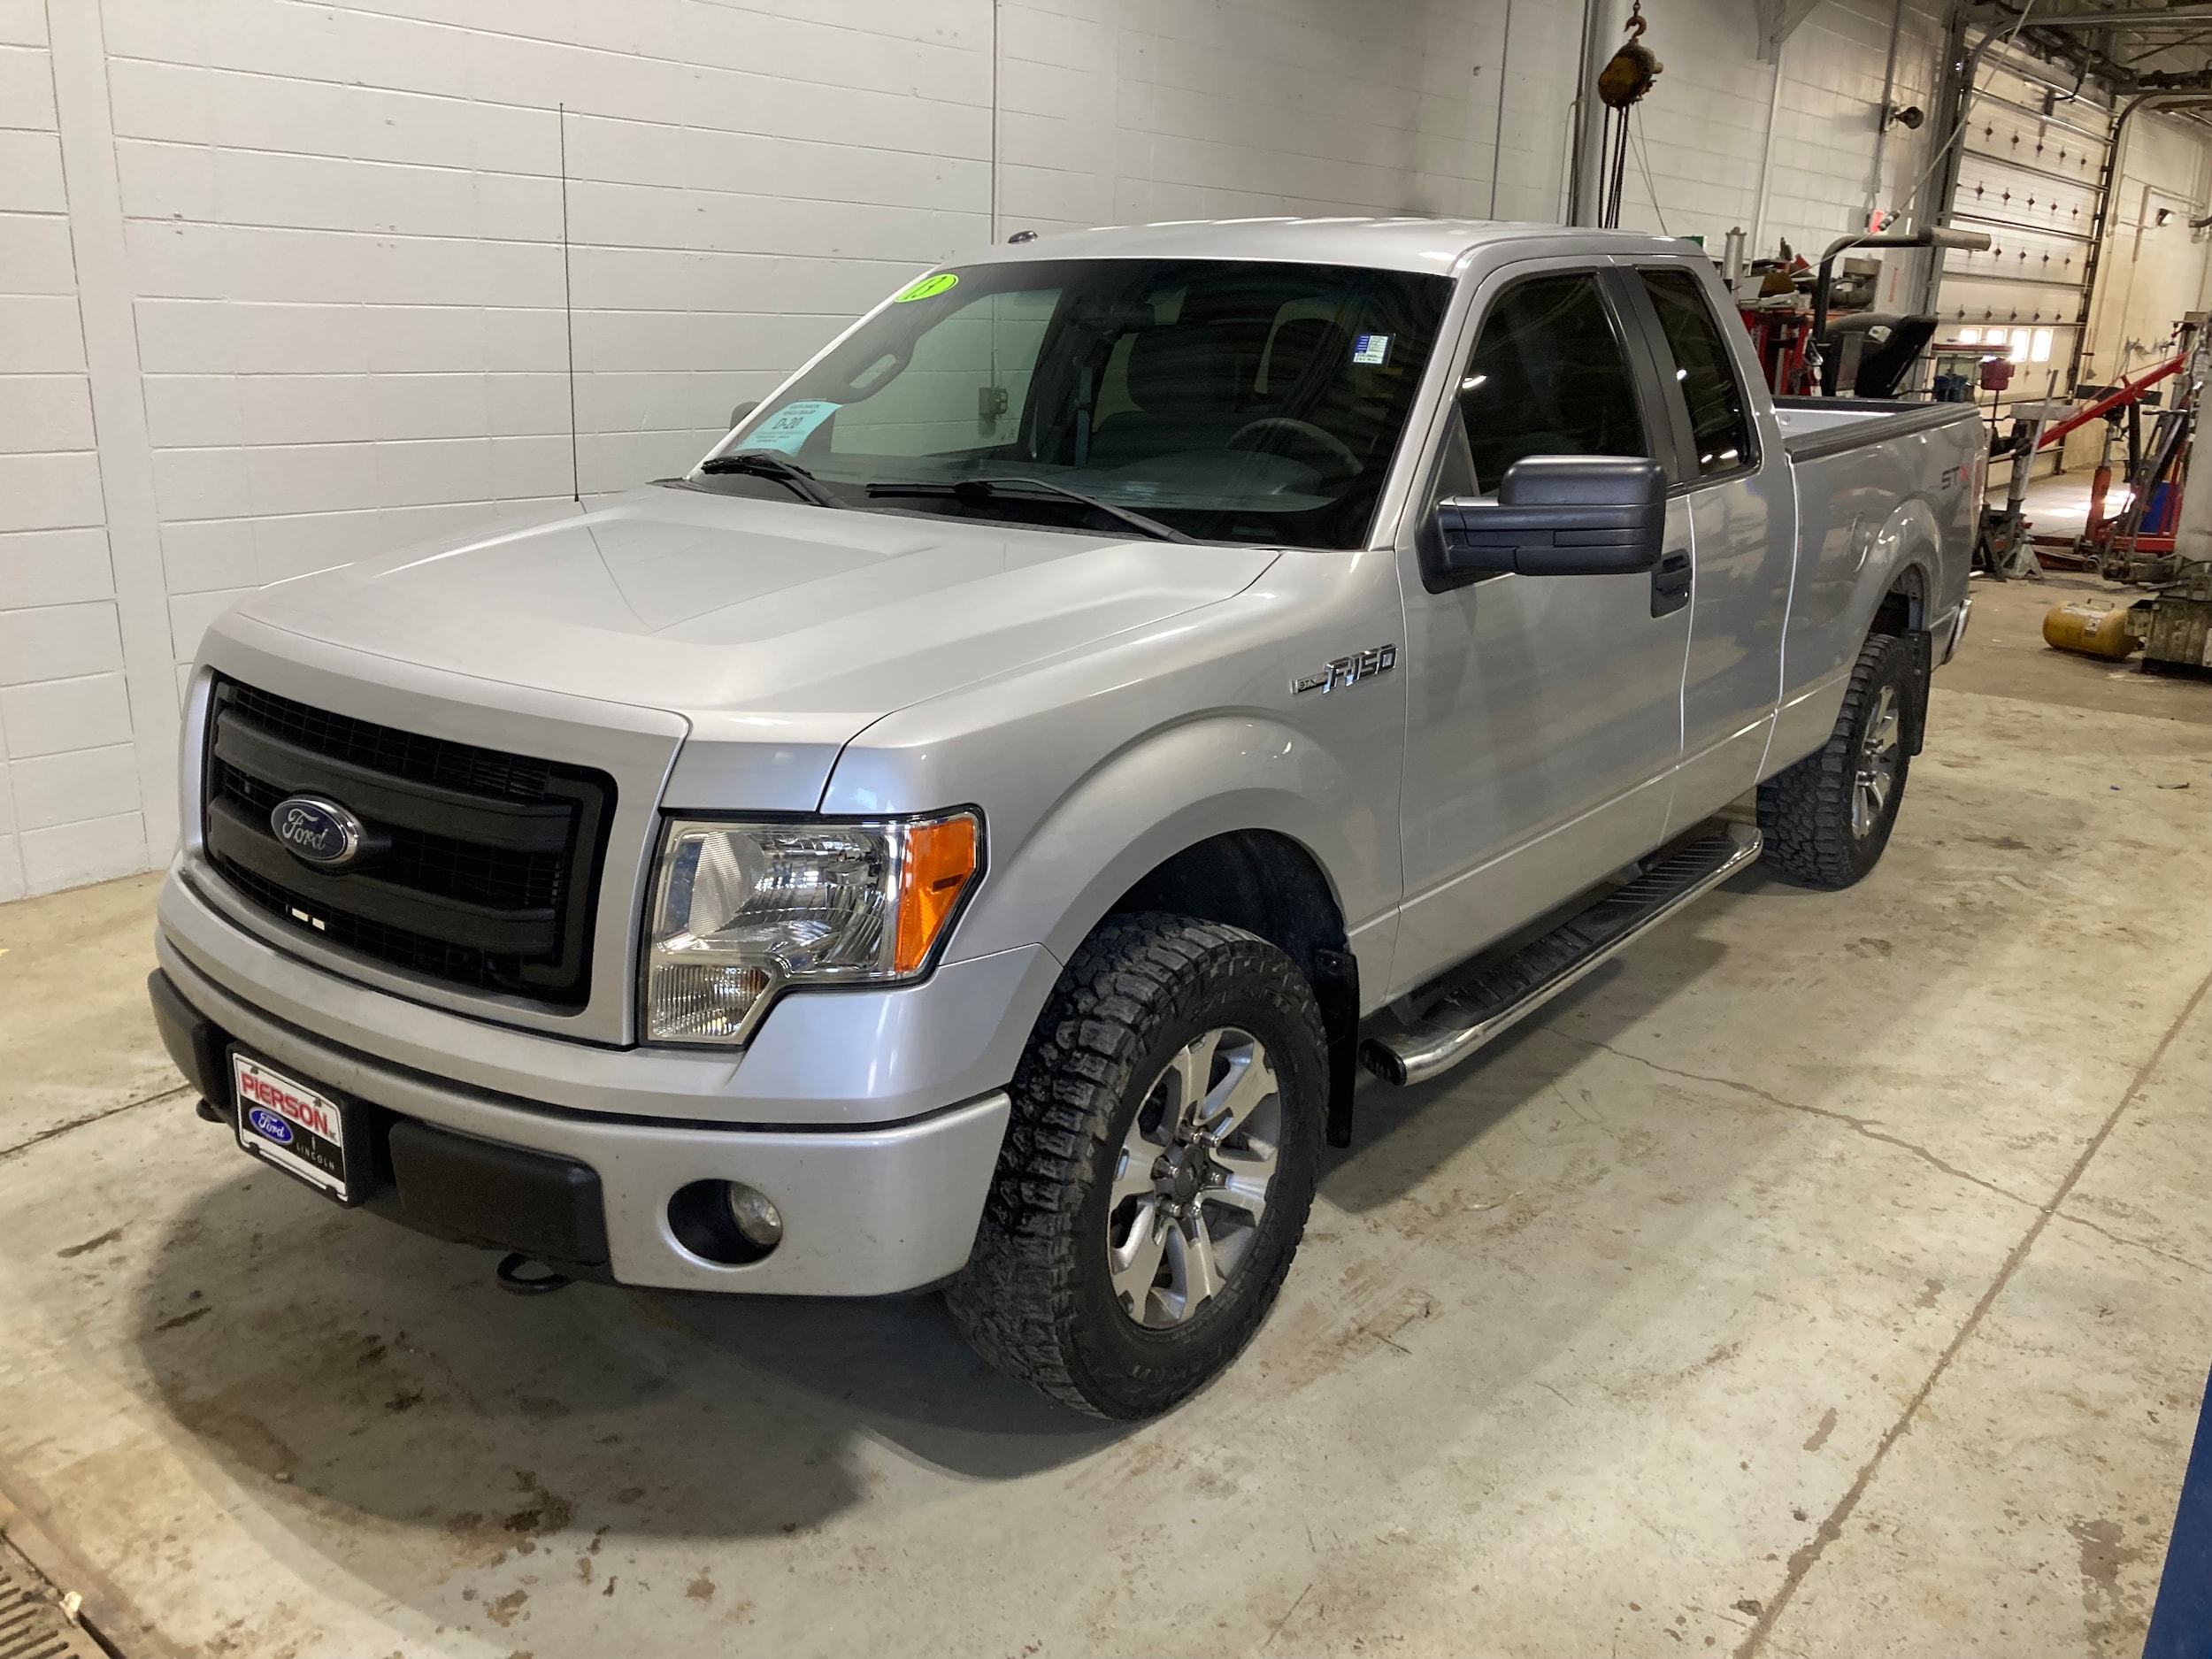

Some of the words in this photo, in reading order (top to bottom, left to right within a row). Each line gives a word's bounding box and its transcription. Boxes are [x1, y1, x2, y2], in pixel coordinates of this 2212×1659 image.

[1941, 463, 1970, 491] STX
[282, 808, 328, 850] Ford
[240, 1071, 328, 1137] PIERSON
[257, 1110, 286, 1140] Ford
[296, 1141, 335, 1171] LINCOLN
